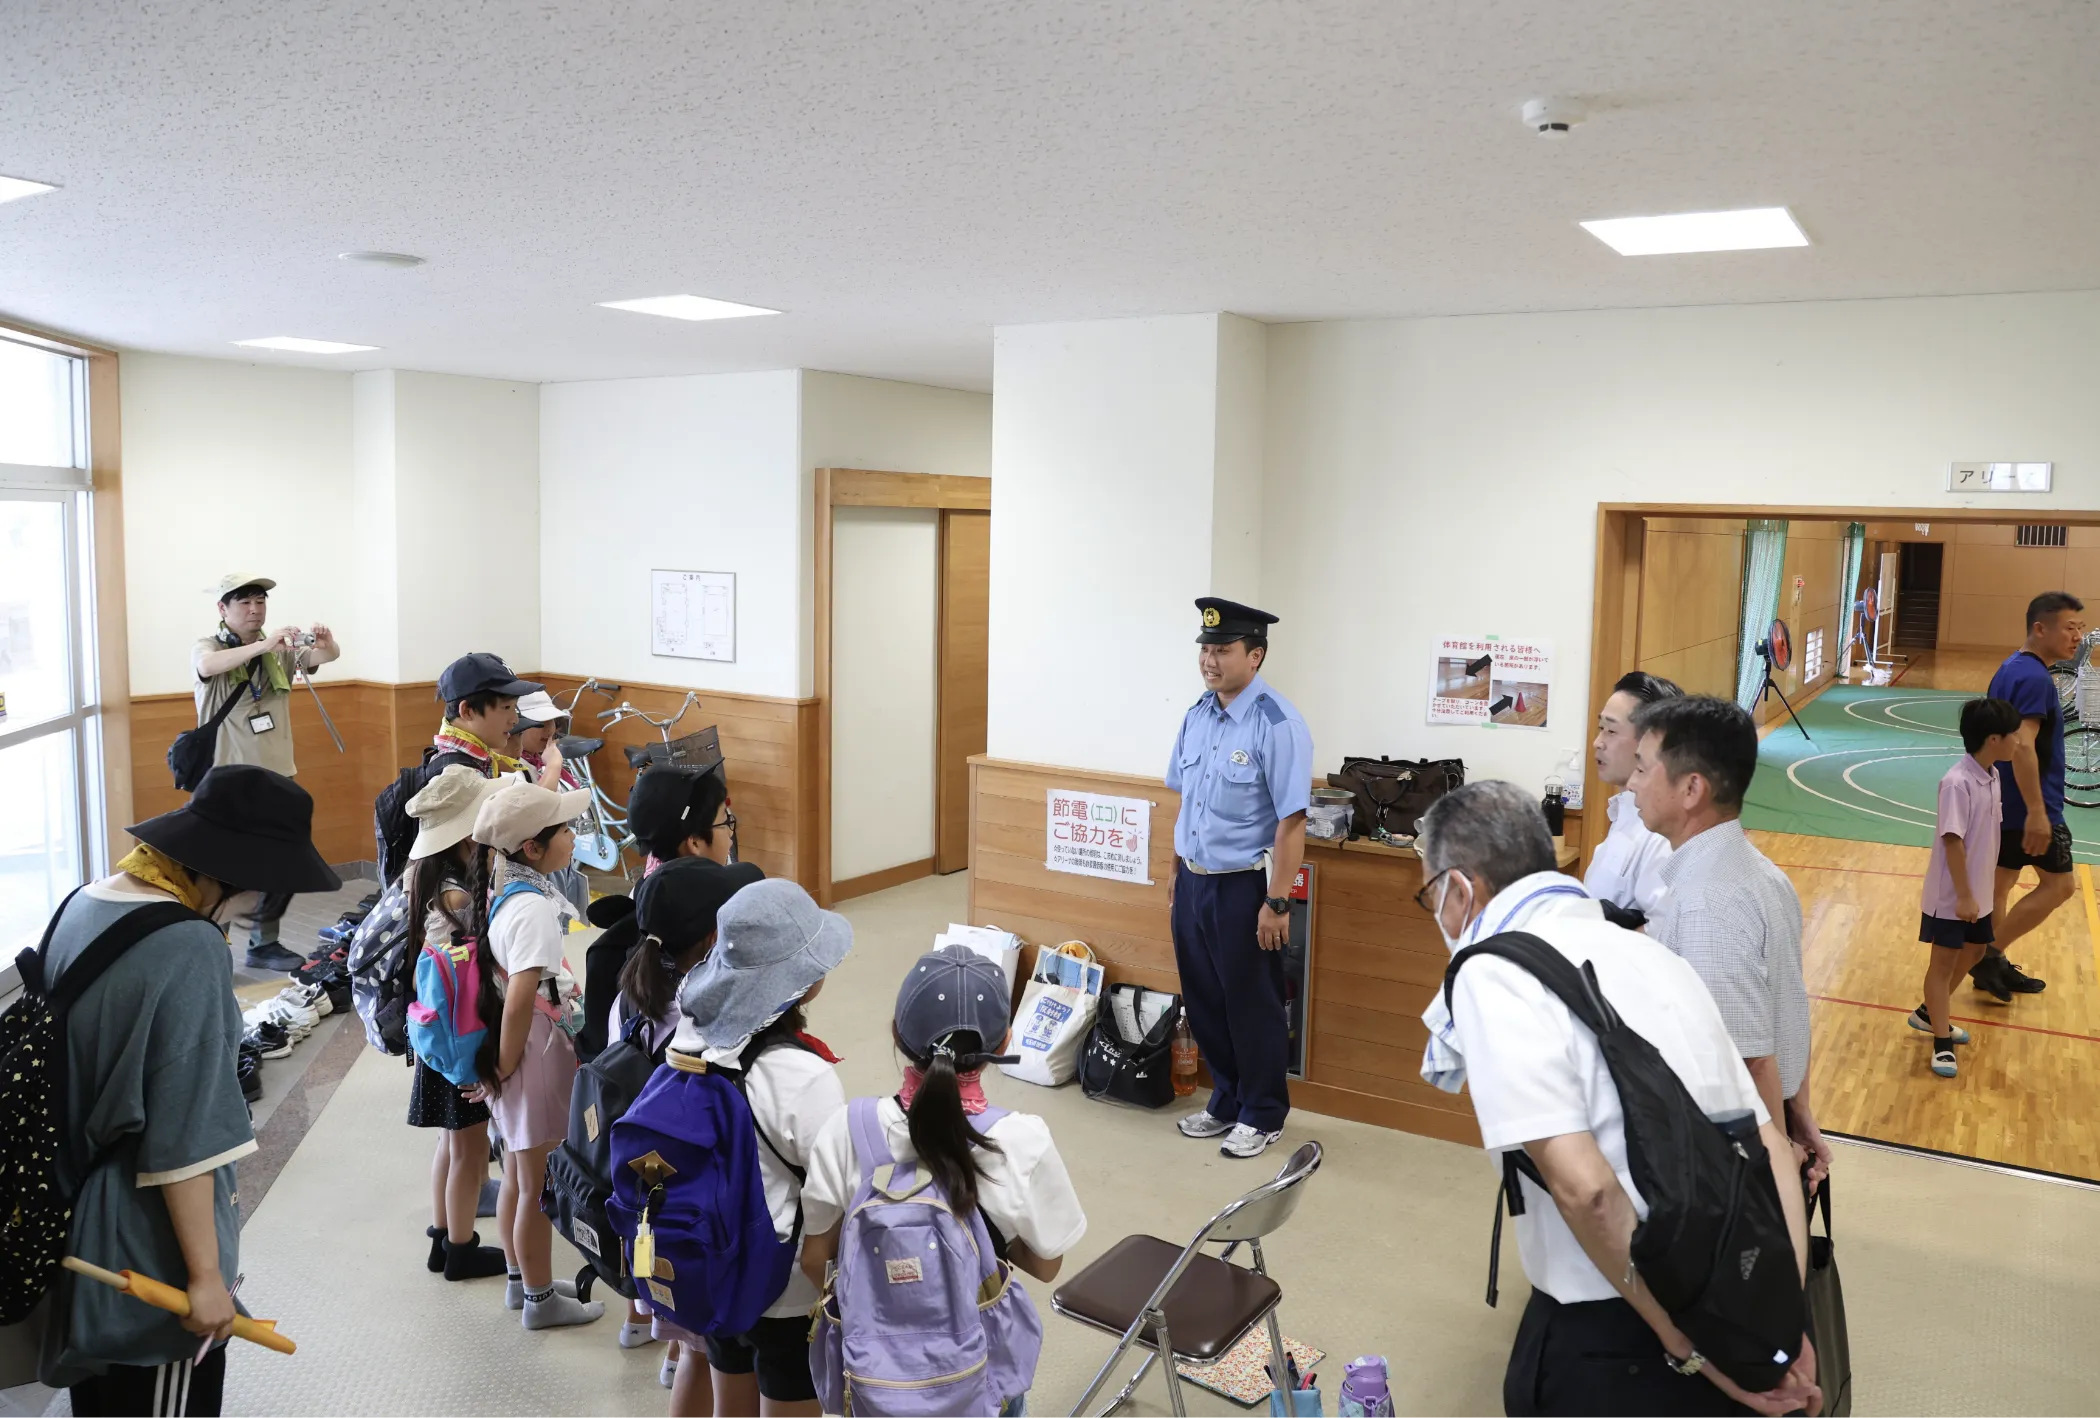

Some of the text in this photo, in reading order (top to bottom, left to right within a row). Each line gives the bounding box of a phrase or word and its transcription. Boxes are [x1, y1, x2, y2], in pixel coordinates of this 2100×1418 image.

[1443, 641, 1541, 654] 体育館を利用される皆様へ
[1053, 821, 1124, 848] ご協力を
